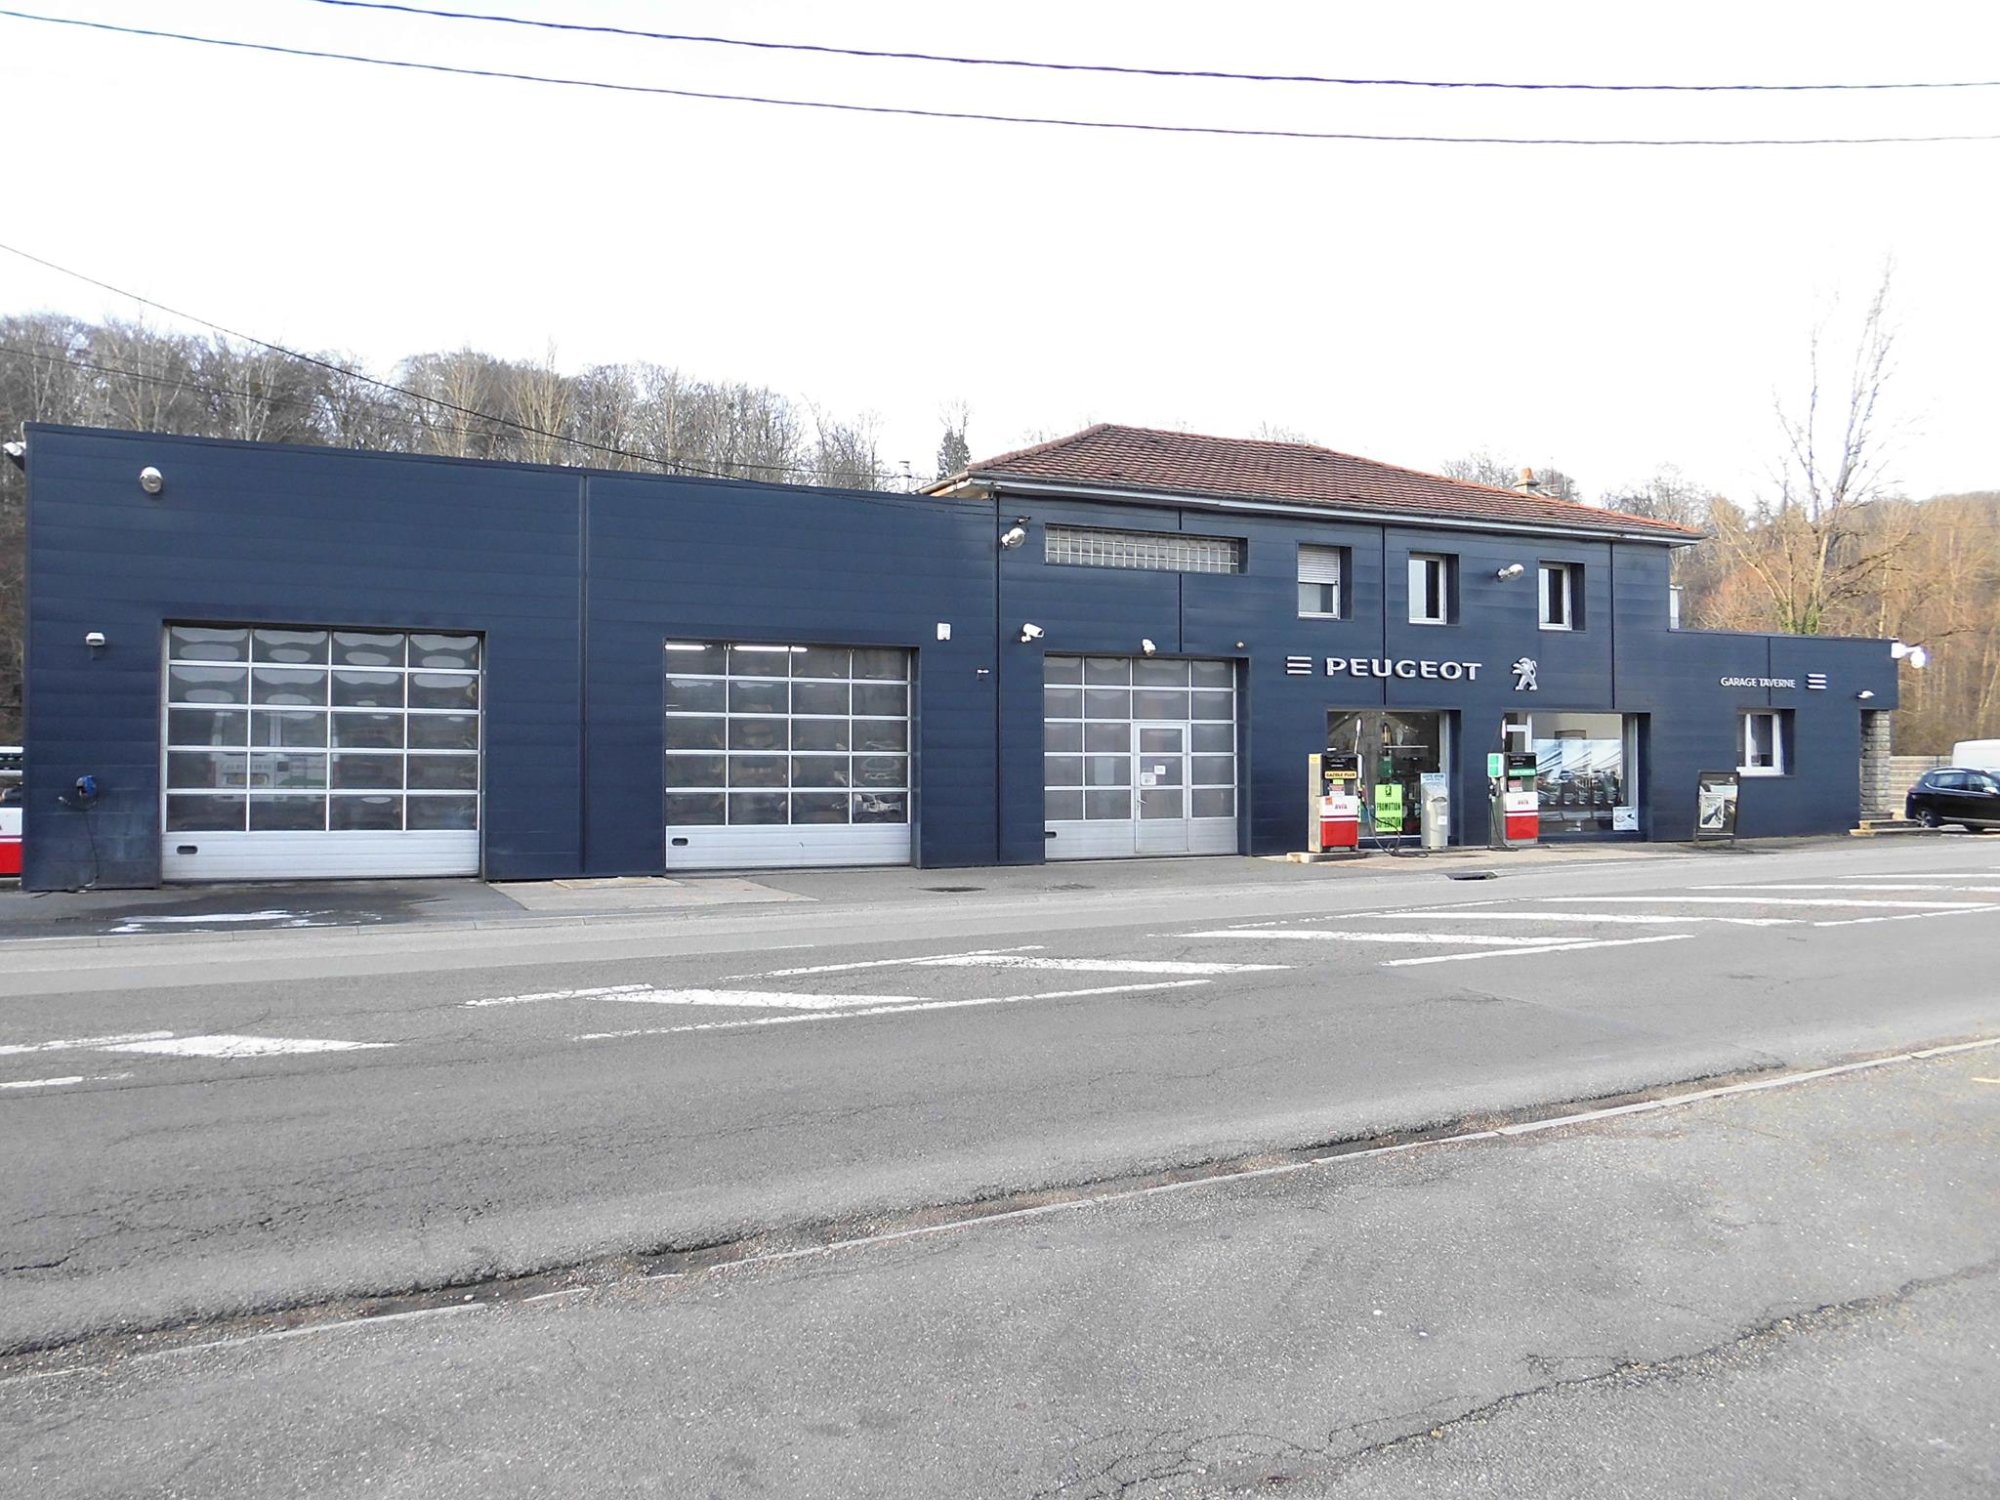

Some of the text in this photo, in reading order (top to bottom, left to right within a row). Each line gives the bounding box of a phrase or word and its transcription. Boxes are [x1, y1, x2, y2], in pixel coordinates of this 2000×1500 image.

[1325, 657, 1482, 681] PEUGEOT
[1720, 676, 1796, 688] GARAGE TAVERNE
